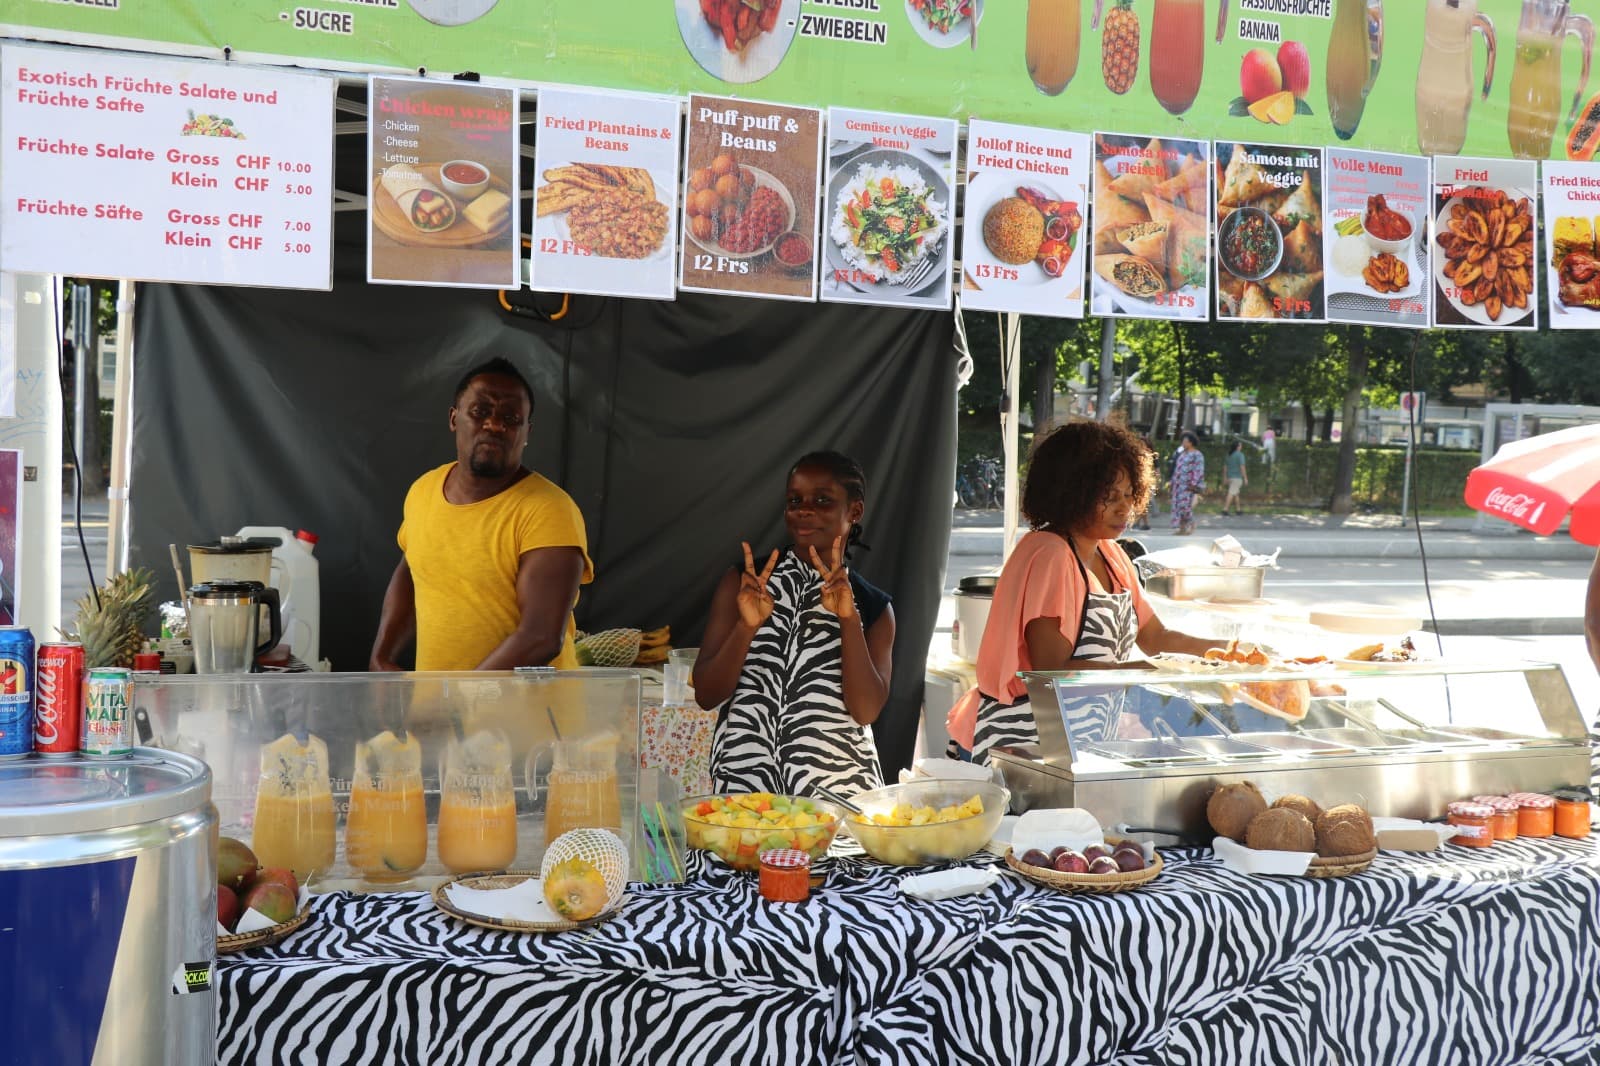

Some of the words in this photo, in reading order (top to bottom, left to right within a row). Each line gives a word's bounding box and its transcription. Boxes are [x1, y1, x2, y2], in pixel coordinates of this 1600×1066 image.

[295, 9, 352, 33] SUCRE
[801, 15, 886, 43] ZWIEBELN
[1240, 20, 1280, 42] BANANA
[18, 68, 98, 89] Exotisch
[105, 76, 173, 95] Früchte
[179, 83, 237, 101] Salate
[243, 90, 278, 105] und
[18, 89, 89, 108] Früchte
[96, 96, 145, 113] Safte
[380, 98, 455, 117] Chicken
[545, 116, 585, 131] Fried
[588, 120, 658, 138] Plantains
[660, 128, 672, 140] &
[699, 107, 781, 132] Puff-puff
[784, 118, 799, 134] &
[846, 119, 891, 134] Gemüse
[900, 126, 937, 140] Veggie
[584, 136, 629, 152] Beans
[720, 132, 777, 152] Beans
[976, 137, 1014, 152] Jollof
[1015, 142, 1044, 155] Rice
[1046, 148, 1073, 159] und
[1101, 143, 1153, 159] Samosa
[18, 136, 89, 156] Früchte
[95, 143, 155, 162] Salate
[166, 149, 220, 166] Gross
[236, 155, 271, 170] CHF
[277, 162, 312, 174] 10.00
[977, 154, 1014, 169] Fried
[1016, 158, 1069, 176] Chicken
[1239, 151, 1292, 167] Samosa
[1295, 154, 1320, 169] mit
[1331, 157, 1365, 172] Volle
[1367, 160, 1403, 177] Menu
[1455, 169, 1489, 182] Fried
[171, 171, 218, 188] Klein
[234, 177, 270, 192] CHF
[285, 184, 312, 196] 5.00
[1257, 171, 1303, 189] Veggie
[1549, 176, 1578, 187] Fried
[1580, 177, 1600, 188] Rice
[17, 198, 88, 218] Früchte
[95, 203, 144, 221] Säfte
[168, 209, 221, 226] Gross
[228, 214, 263, 229] CHF
[284, 220, 312, 233] 7.00
[165, 231, 212, 247] Klein
[228, 236, 263, 251] CHF
[284, 242, 312, 254] 5.00
[540, 238, 558, 253] 12
[562, 240, 593, 257] Frs
[694, 254, 713, 271] 12
[717, 256, 749, 274] Frs
[975, 264, 990, 279] 13
[993, 266, 1019, 281] Frs
[1167, 292, 1195, 308] Frs
[1445, 287, 1452, 298] 5
[1285, 299, 1311, 312] Frs
[36, 669, 58, 745] Cola
[89, 693, 126, 707] VITA
[85, 705, 128, 721] MALT
